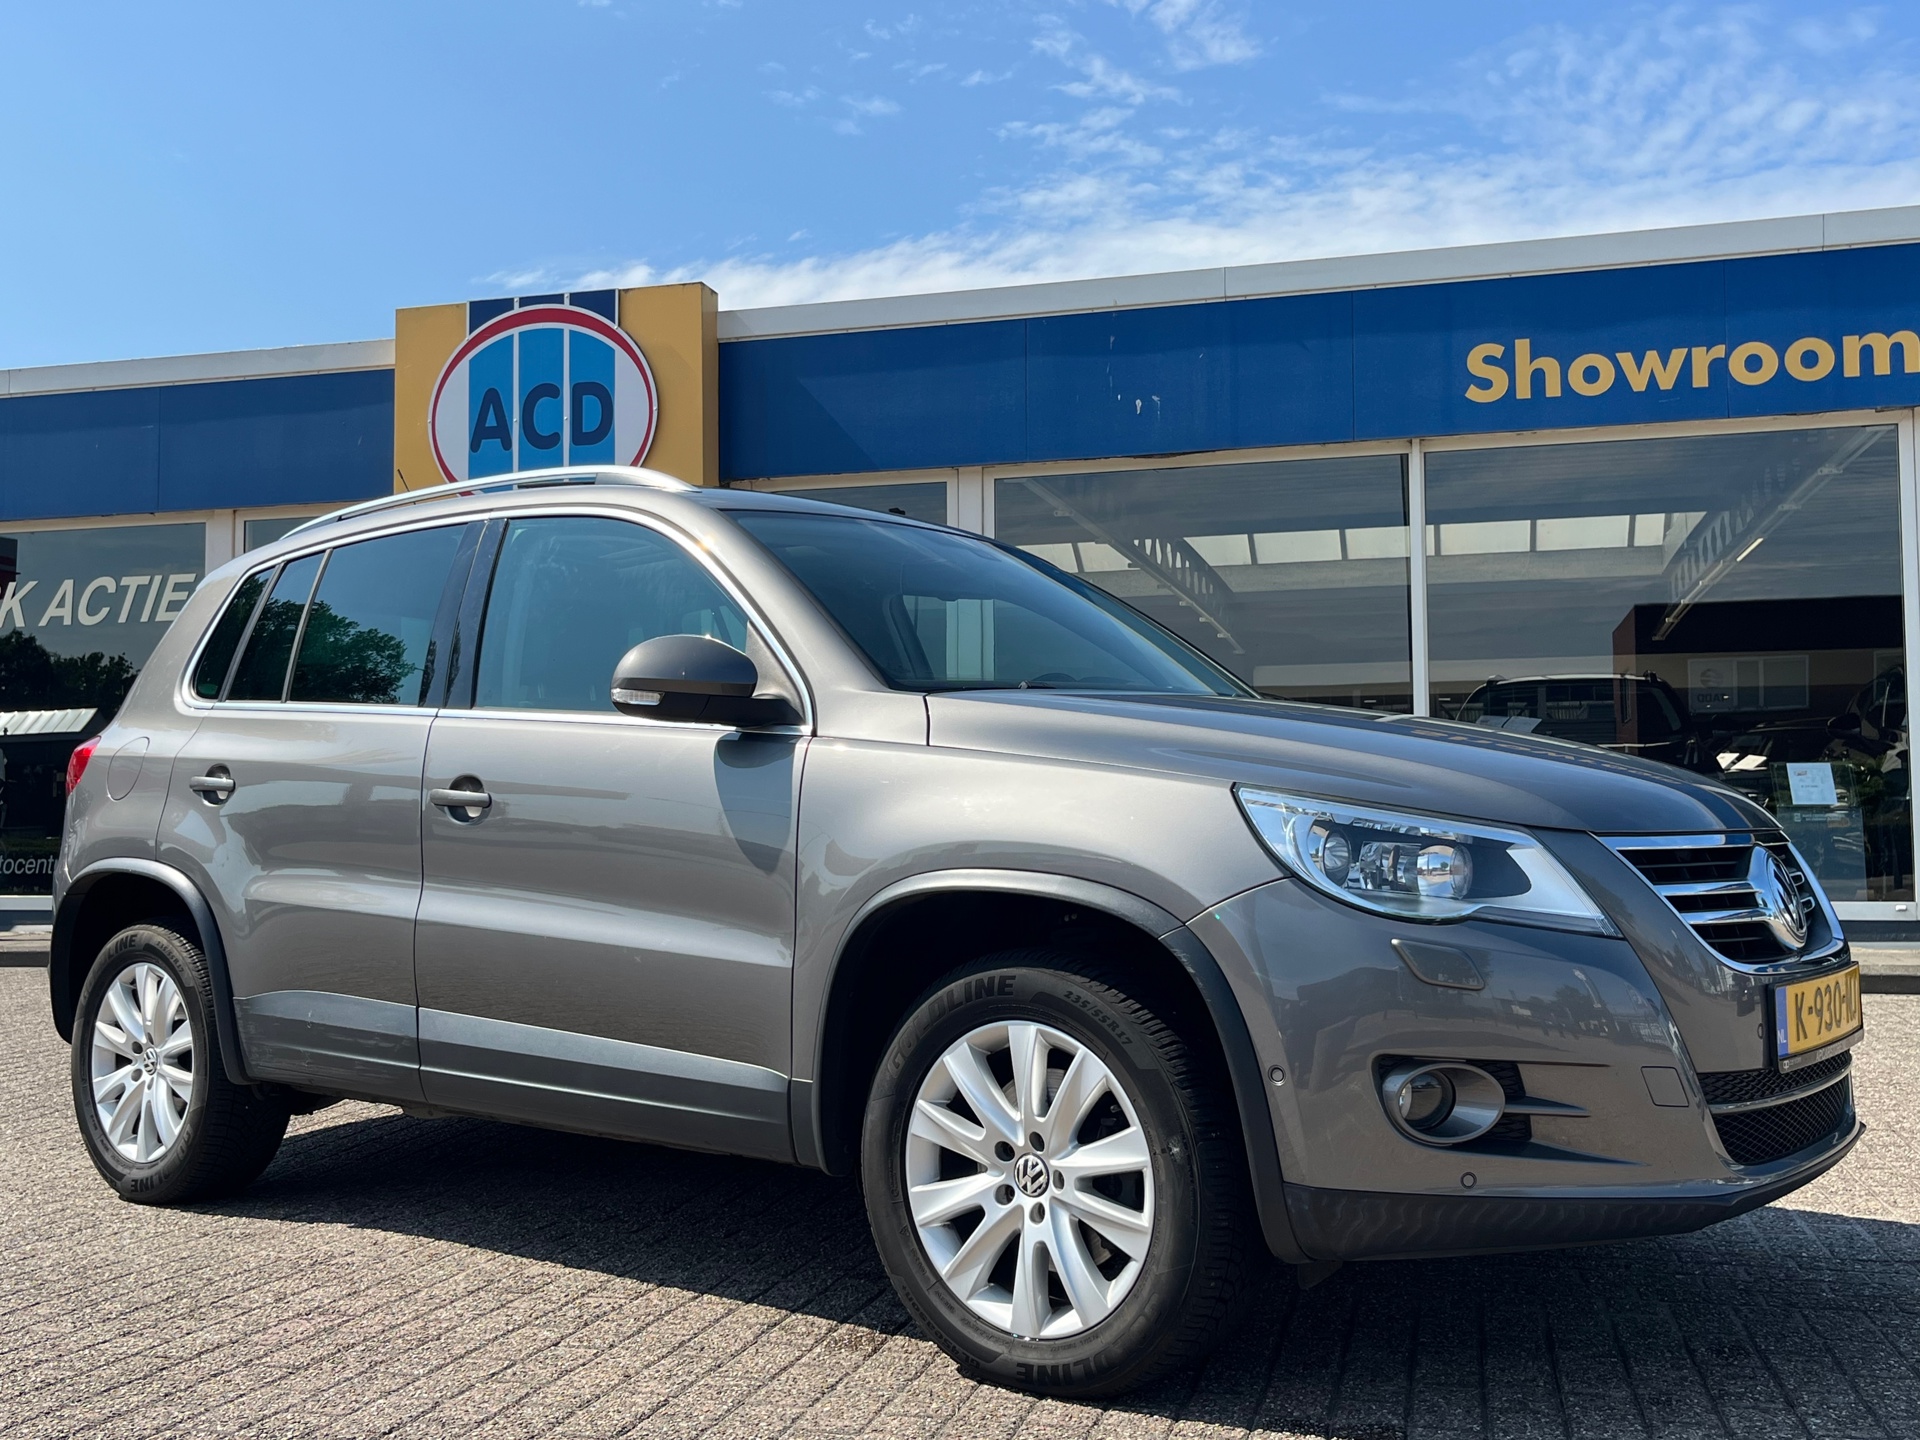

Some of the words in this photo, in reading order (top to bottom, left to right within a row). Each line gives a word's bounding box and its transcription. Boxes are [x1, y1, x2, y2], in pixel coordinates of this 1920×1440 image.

[1465, 330, 1920, 403] Showroom
[470, 380, 615, 454] ACD
[38, 573, 197, 627] ACTIE
[886, 975, 1016, 1080] GOLDLINE
[1062, 990, 1133, 1046] 235/55R17
[1777, 1028, 1787, 1044] NL
